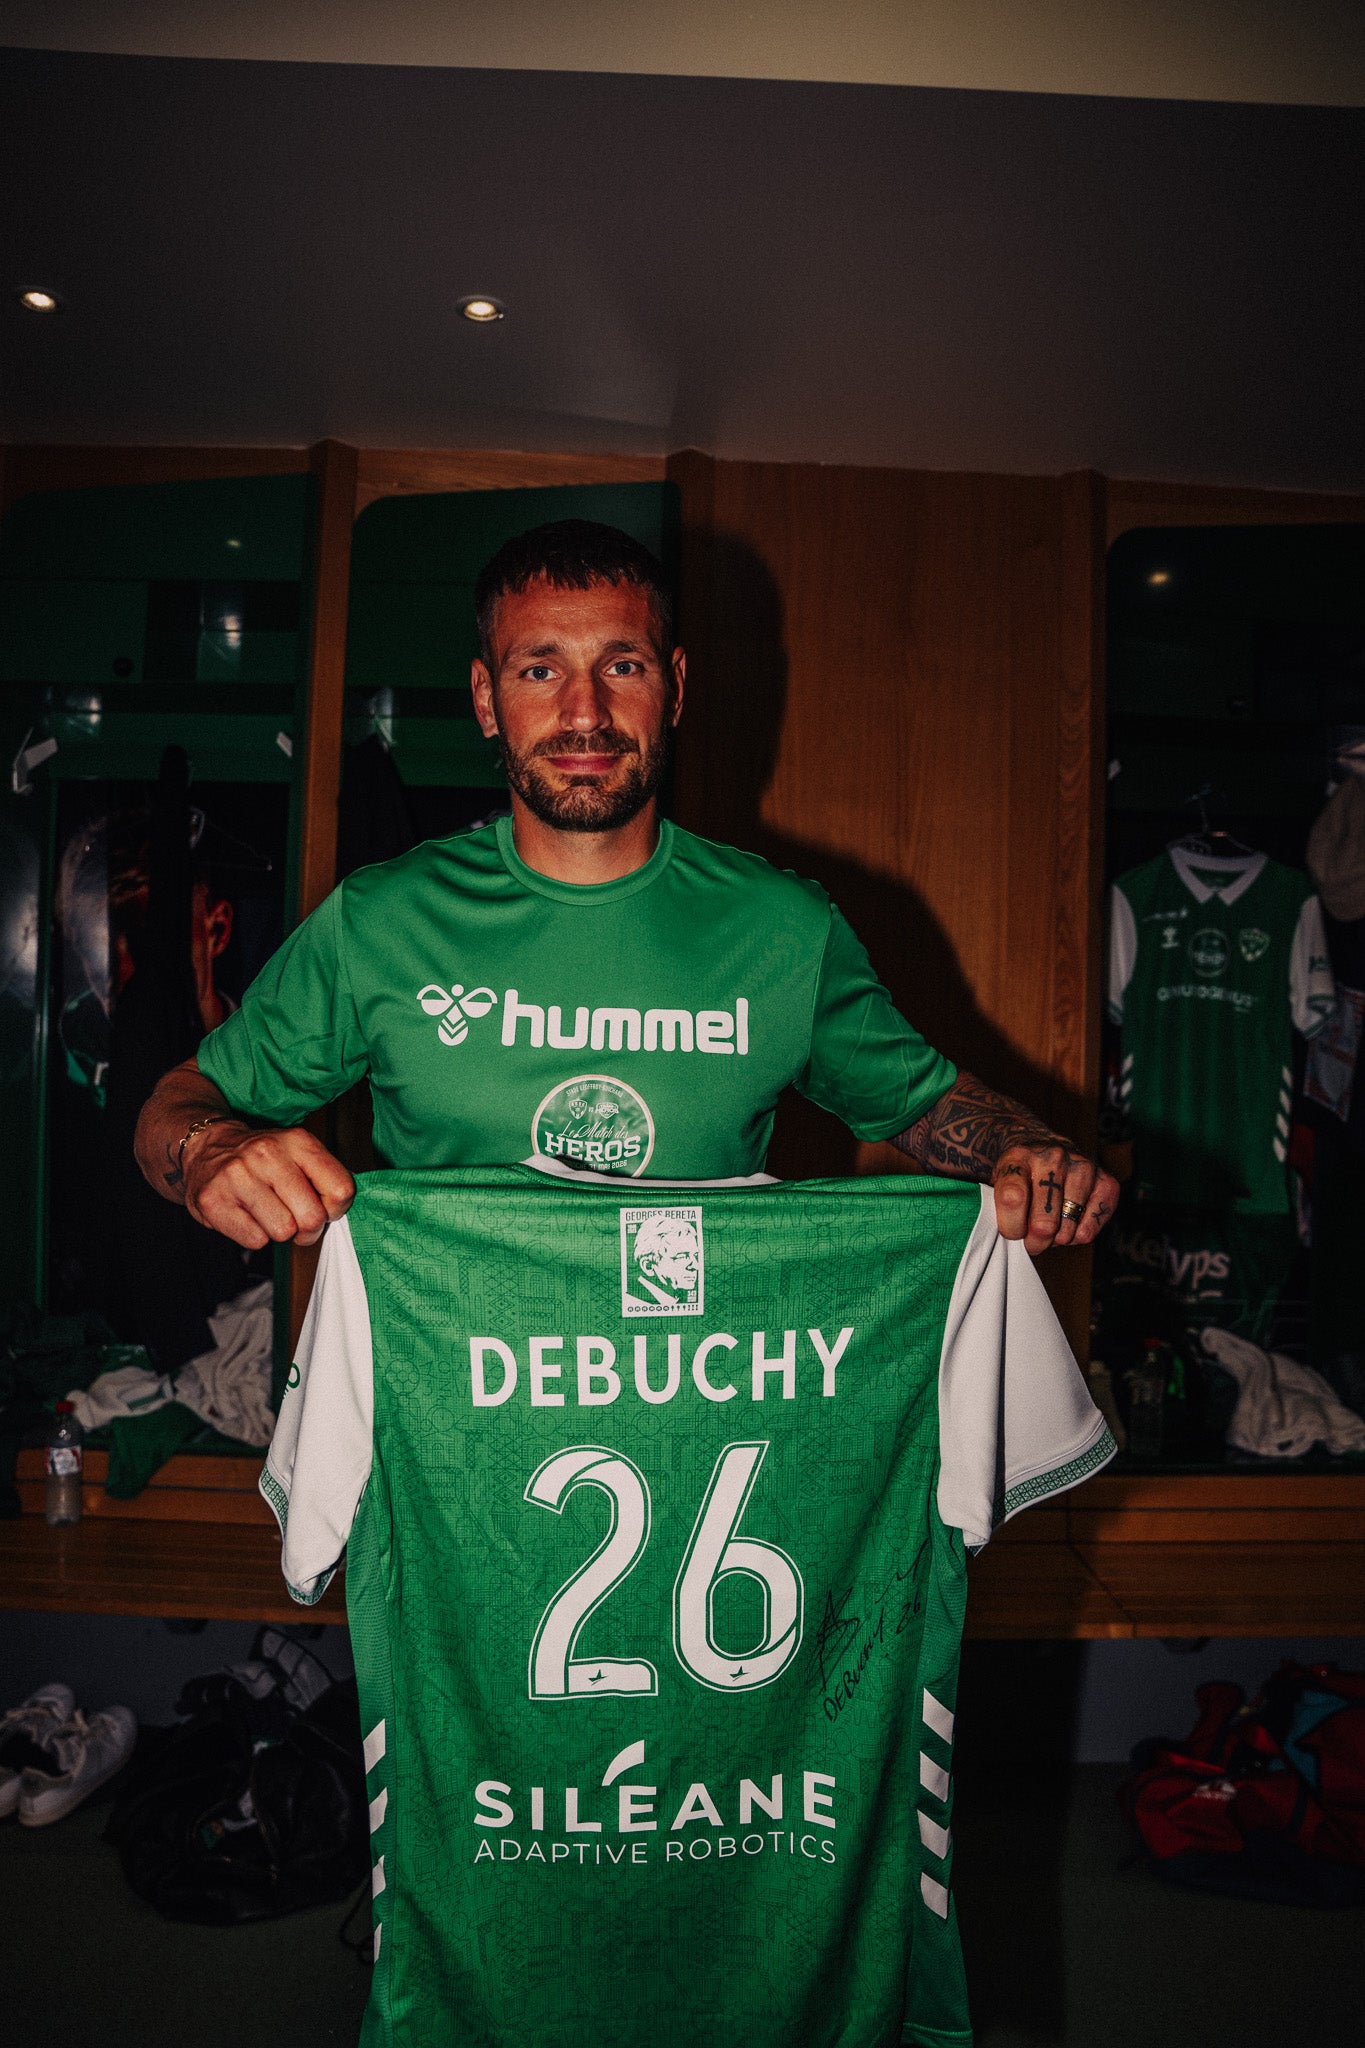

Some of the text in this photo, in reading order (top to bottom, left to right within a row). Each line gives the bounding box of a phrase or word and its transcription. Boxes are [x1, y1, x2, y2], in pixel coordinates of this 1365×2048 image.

[501, 989, 748, 1055] hummel
[625, 1209, 697, 1222] GEORGES BERETA
[469, 1328, 855, 1406] DEBUCHY
[523, 1441, 805, 1700] 26
[475, 1833, 836, 1865] ADAPTIVE ROBOTICS
